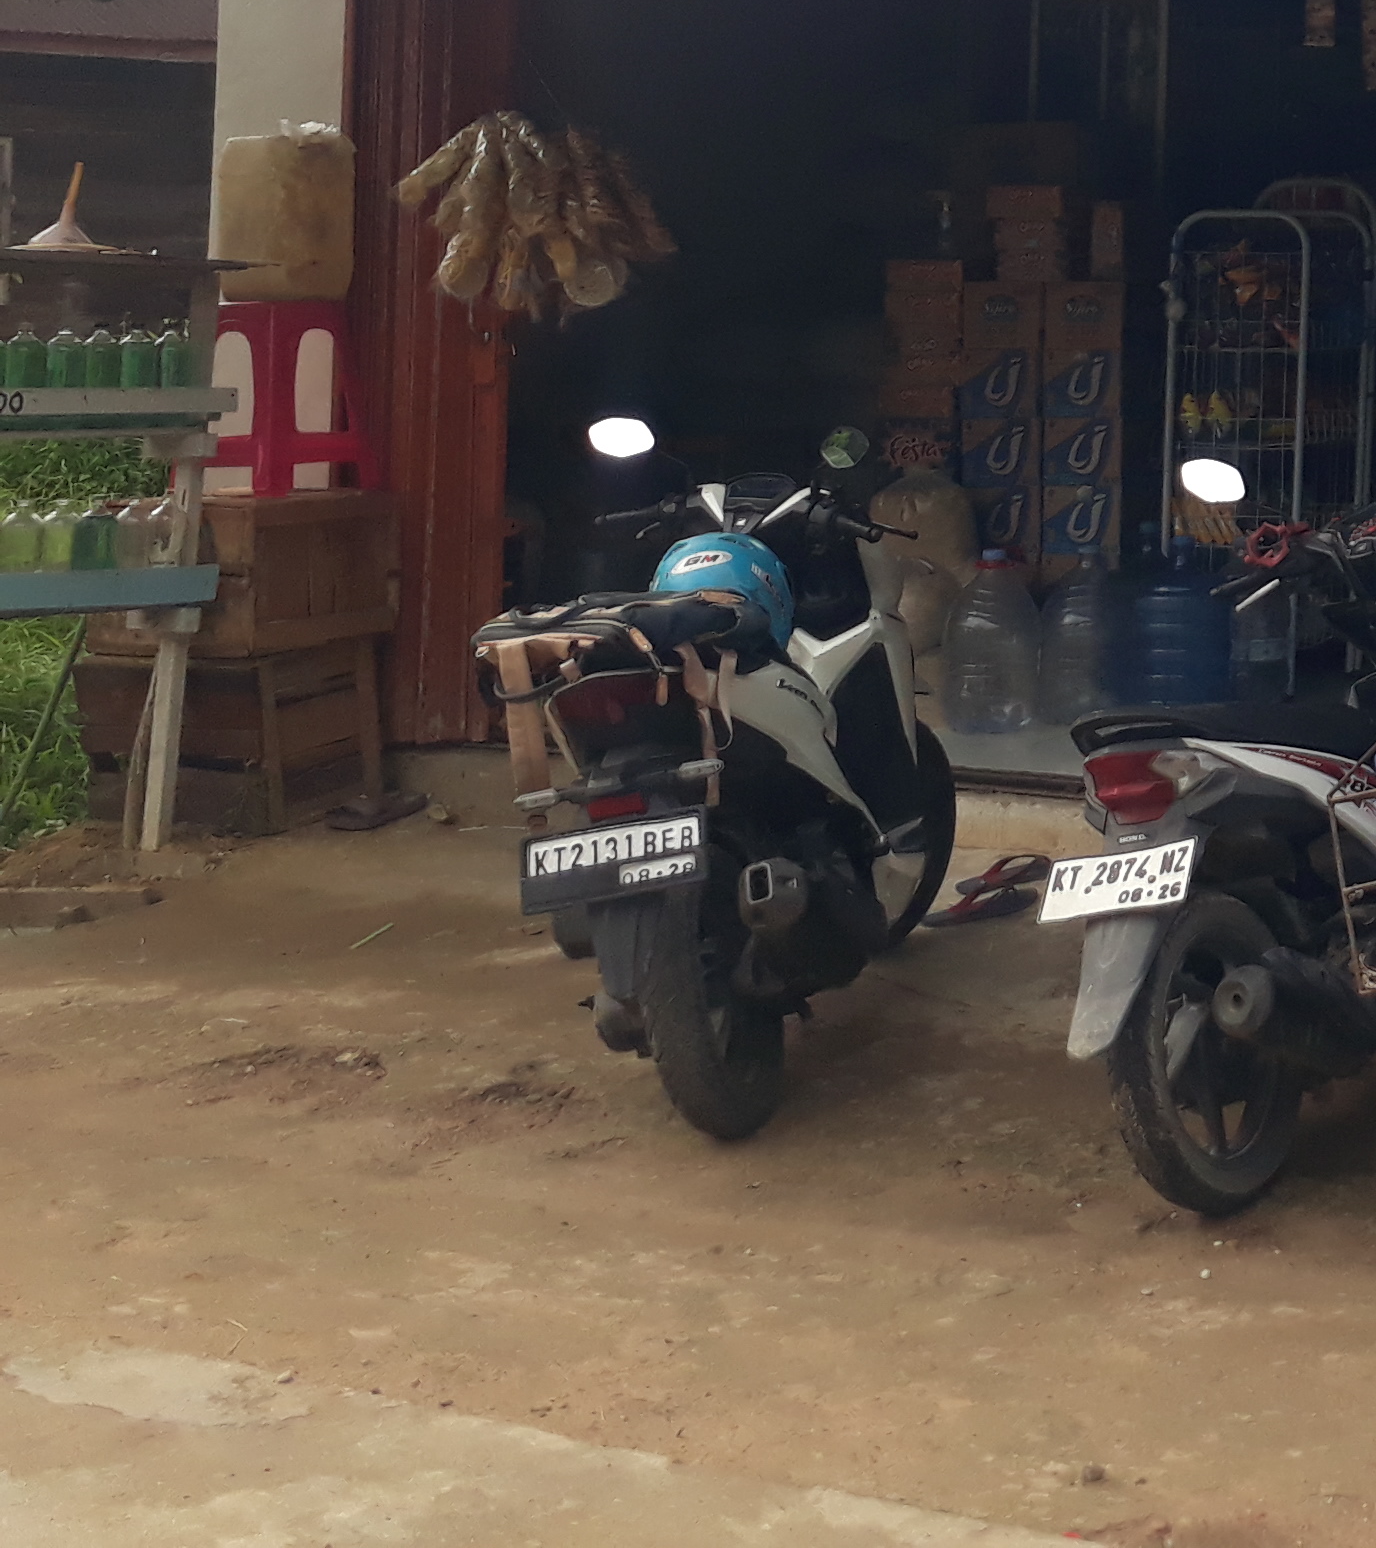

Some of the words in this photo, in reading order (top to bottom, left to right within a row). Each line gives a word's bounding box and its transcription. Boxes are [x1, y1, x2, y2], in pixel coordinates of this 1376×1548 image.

[683, 553, 720, 568] GM
[1051, 865, 1083, 893] KT
[1159, 845, 1190, 875] NZ
